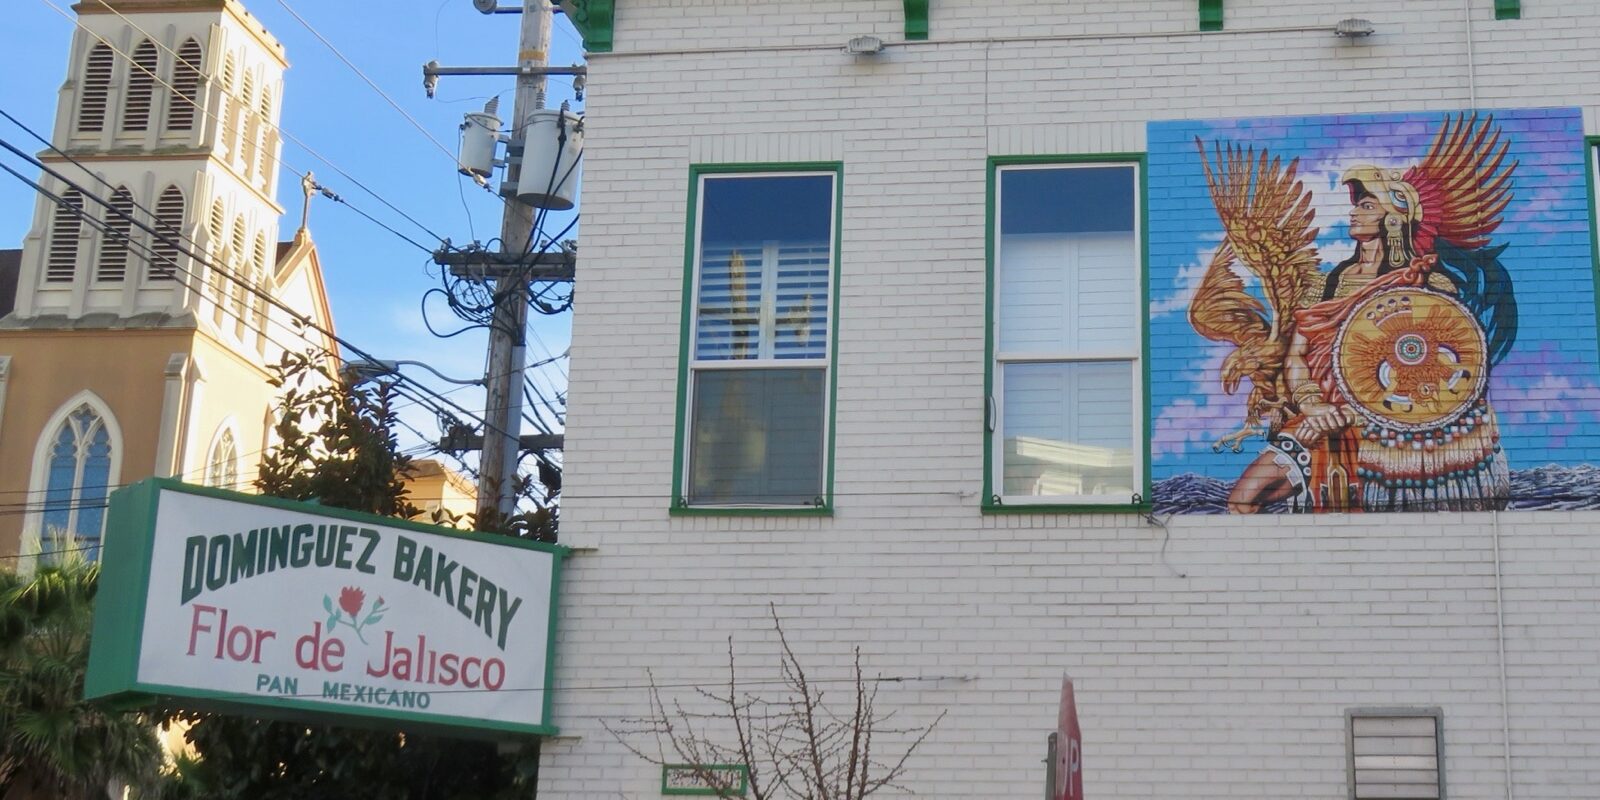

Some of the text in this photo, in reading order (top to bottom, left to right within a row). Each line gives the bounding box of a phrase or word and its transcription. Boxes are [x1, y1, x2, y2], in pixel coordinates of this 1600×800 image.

[181, 524, 522, 651] DOMINGUEZ BAKERY
[186, 604, 506, 691] Flor de Jalisco
[256, 674, 430, 709] PAN MEXICANO
